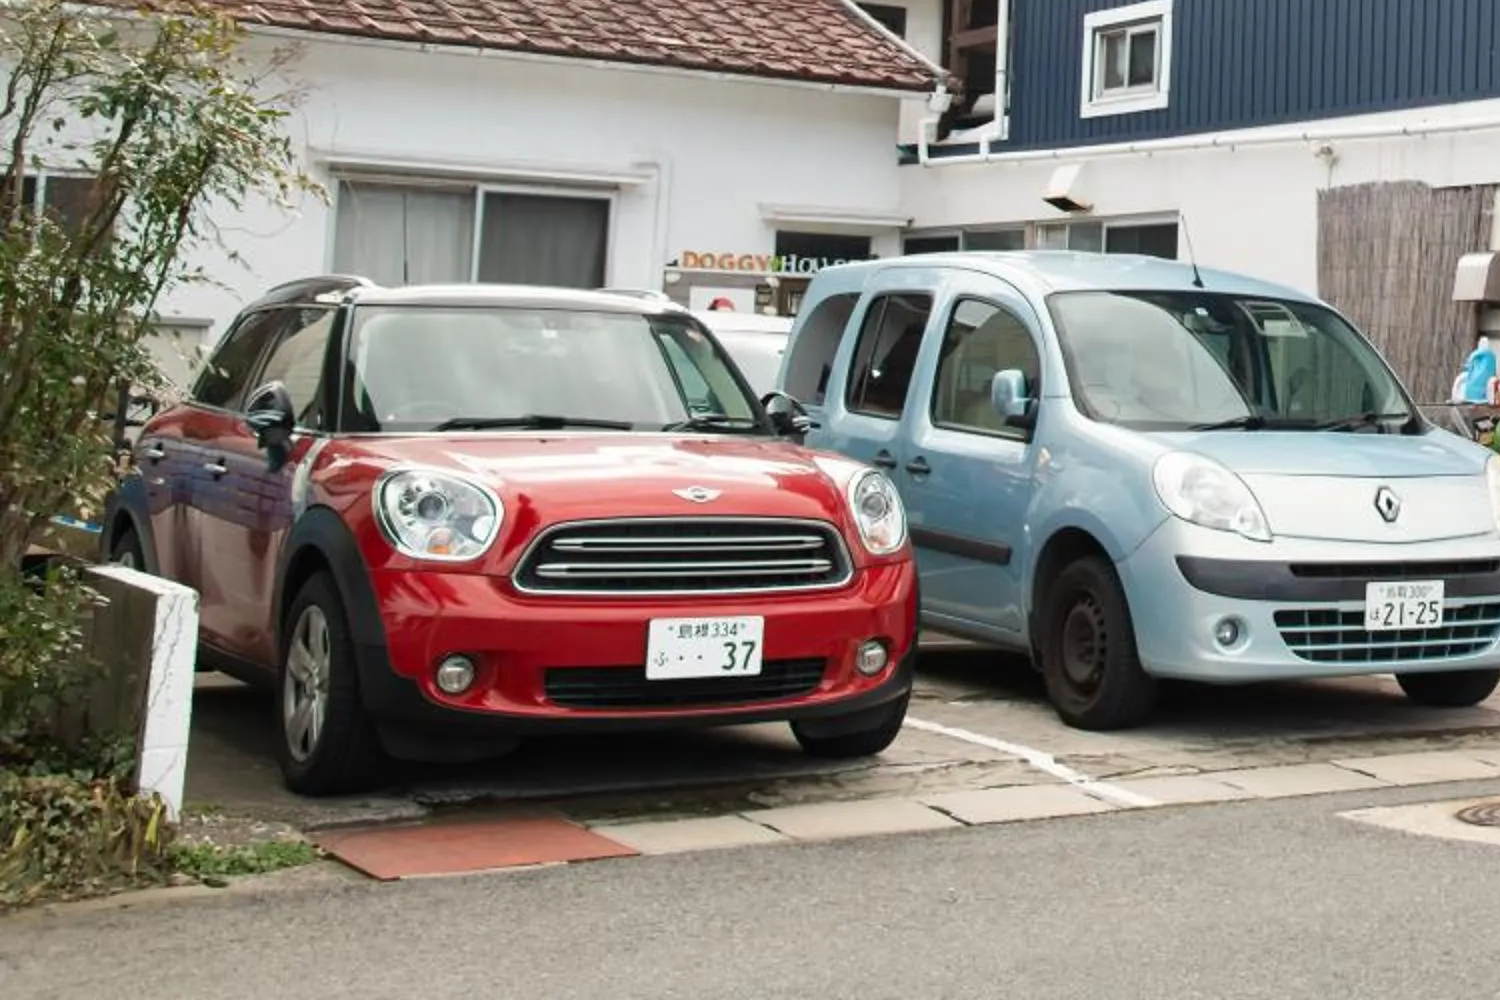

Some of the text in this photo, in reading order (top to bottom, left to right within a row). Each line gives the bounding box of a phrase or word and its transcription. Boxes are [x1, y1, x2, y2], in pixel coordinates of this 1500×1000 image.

[683, 250, 862, 275] DOGGY HOU
[1383, 600, 1439, 626] 21-25
[721, 640, 755, 670] 37
